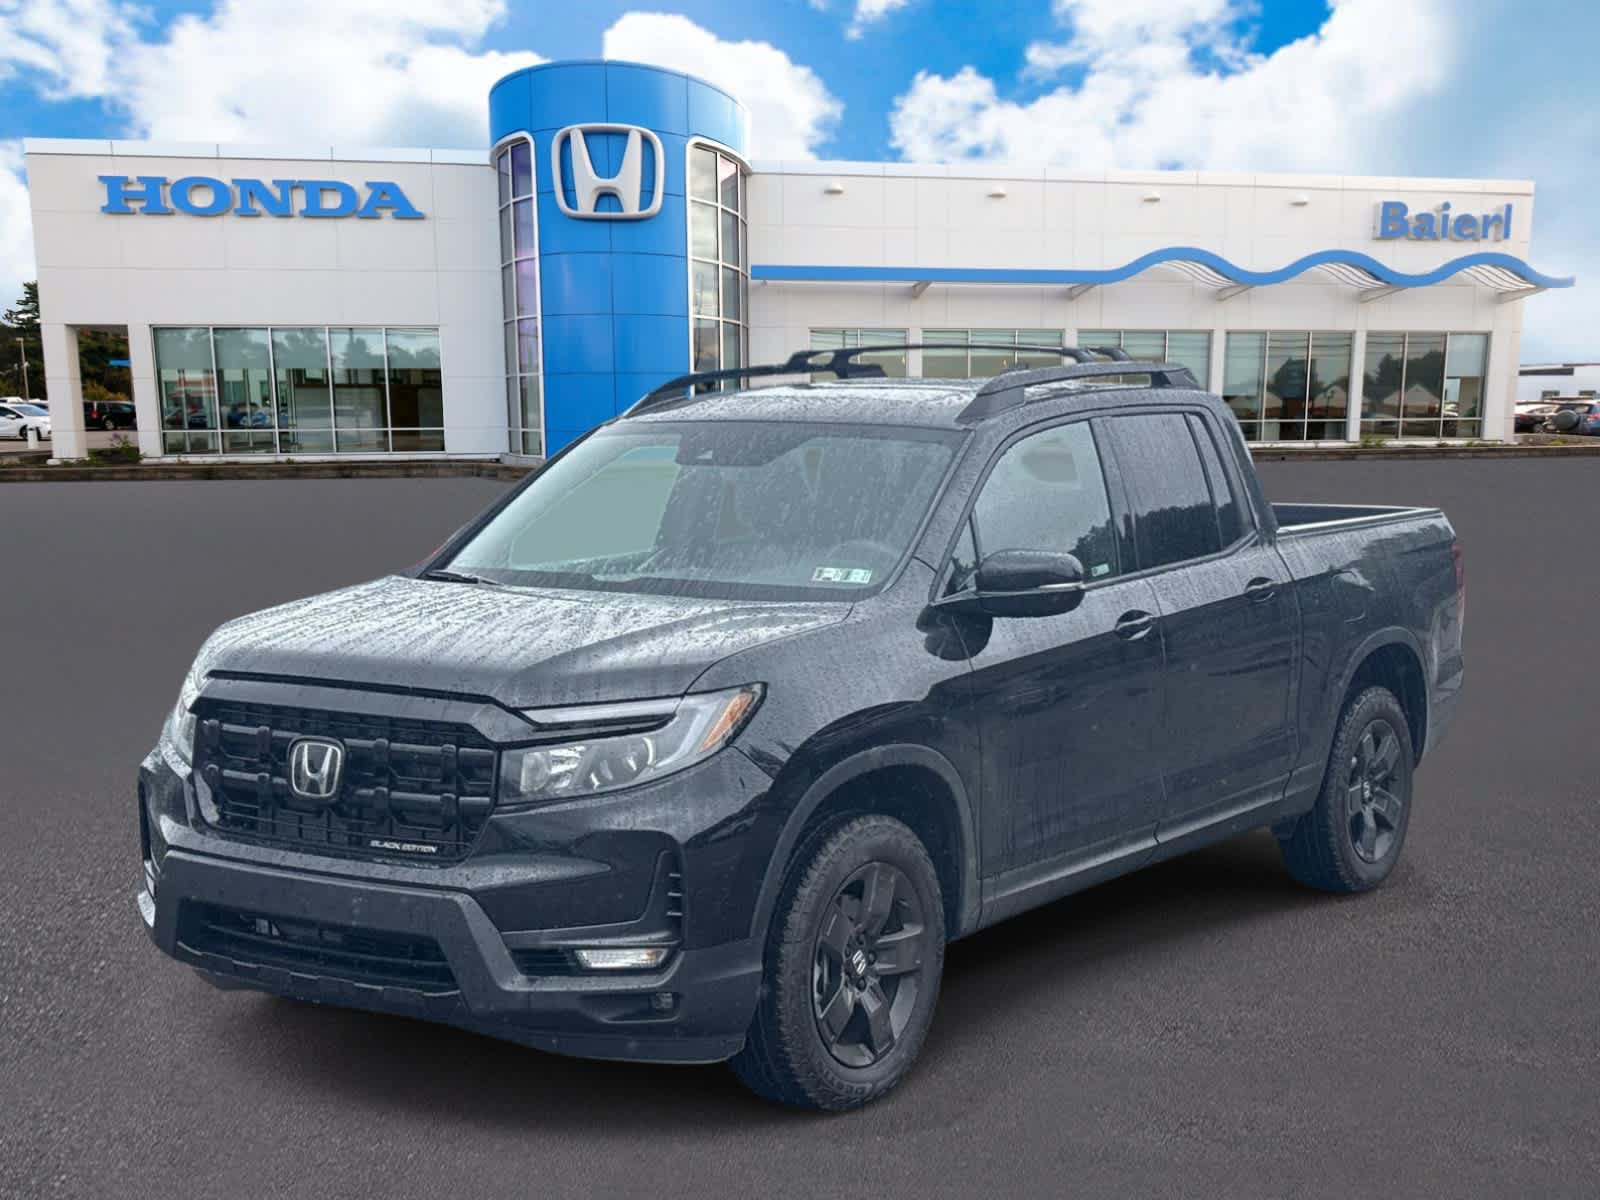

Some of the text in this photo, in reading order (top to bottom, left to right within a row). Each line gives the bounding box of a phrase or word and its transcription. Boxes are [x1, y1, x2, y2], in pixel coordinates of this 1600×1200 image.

[98, 175, 425, 219] HONDA
[1379, 200, 1513, 240] Baierl
[370, 840, 400, 850] BLACK
